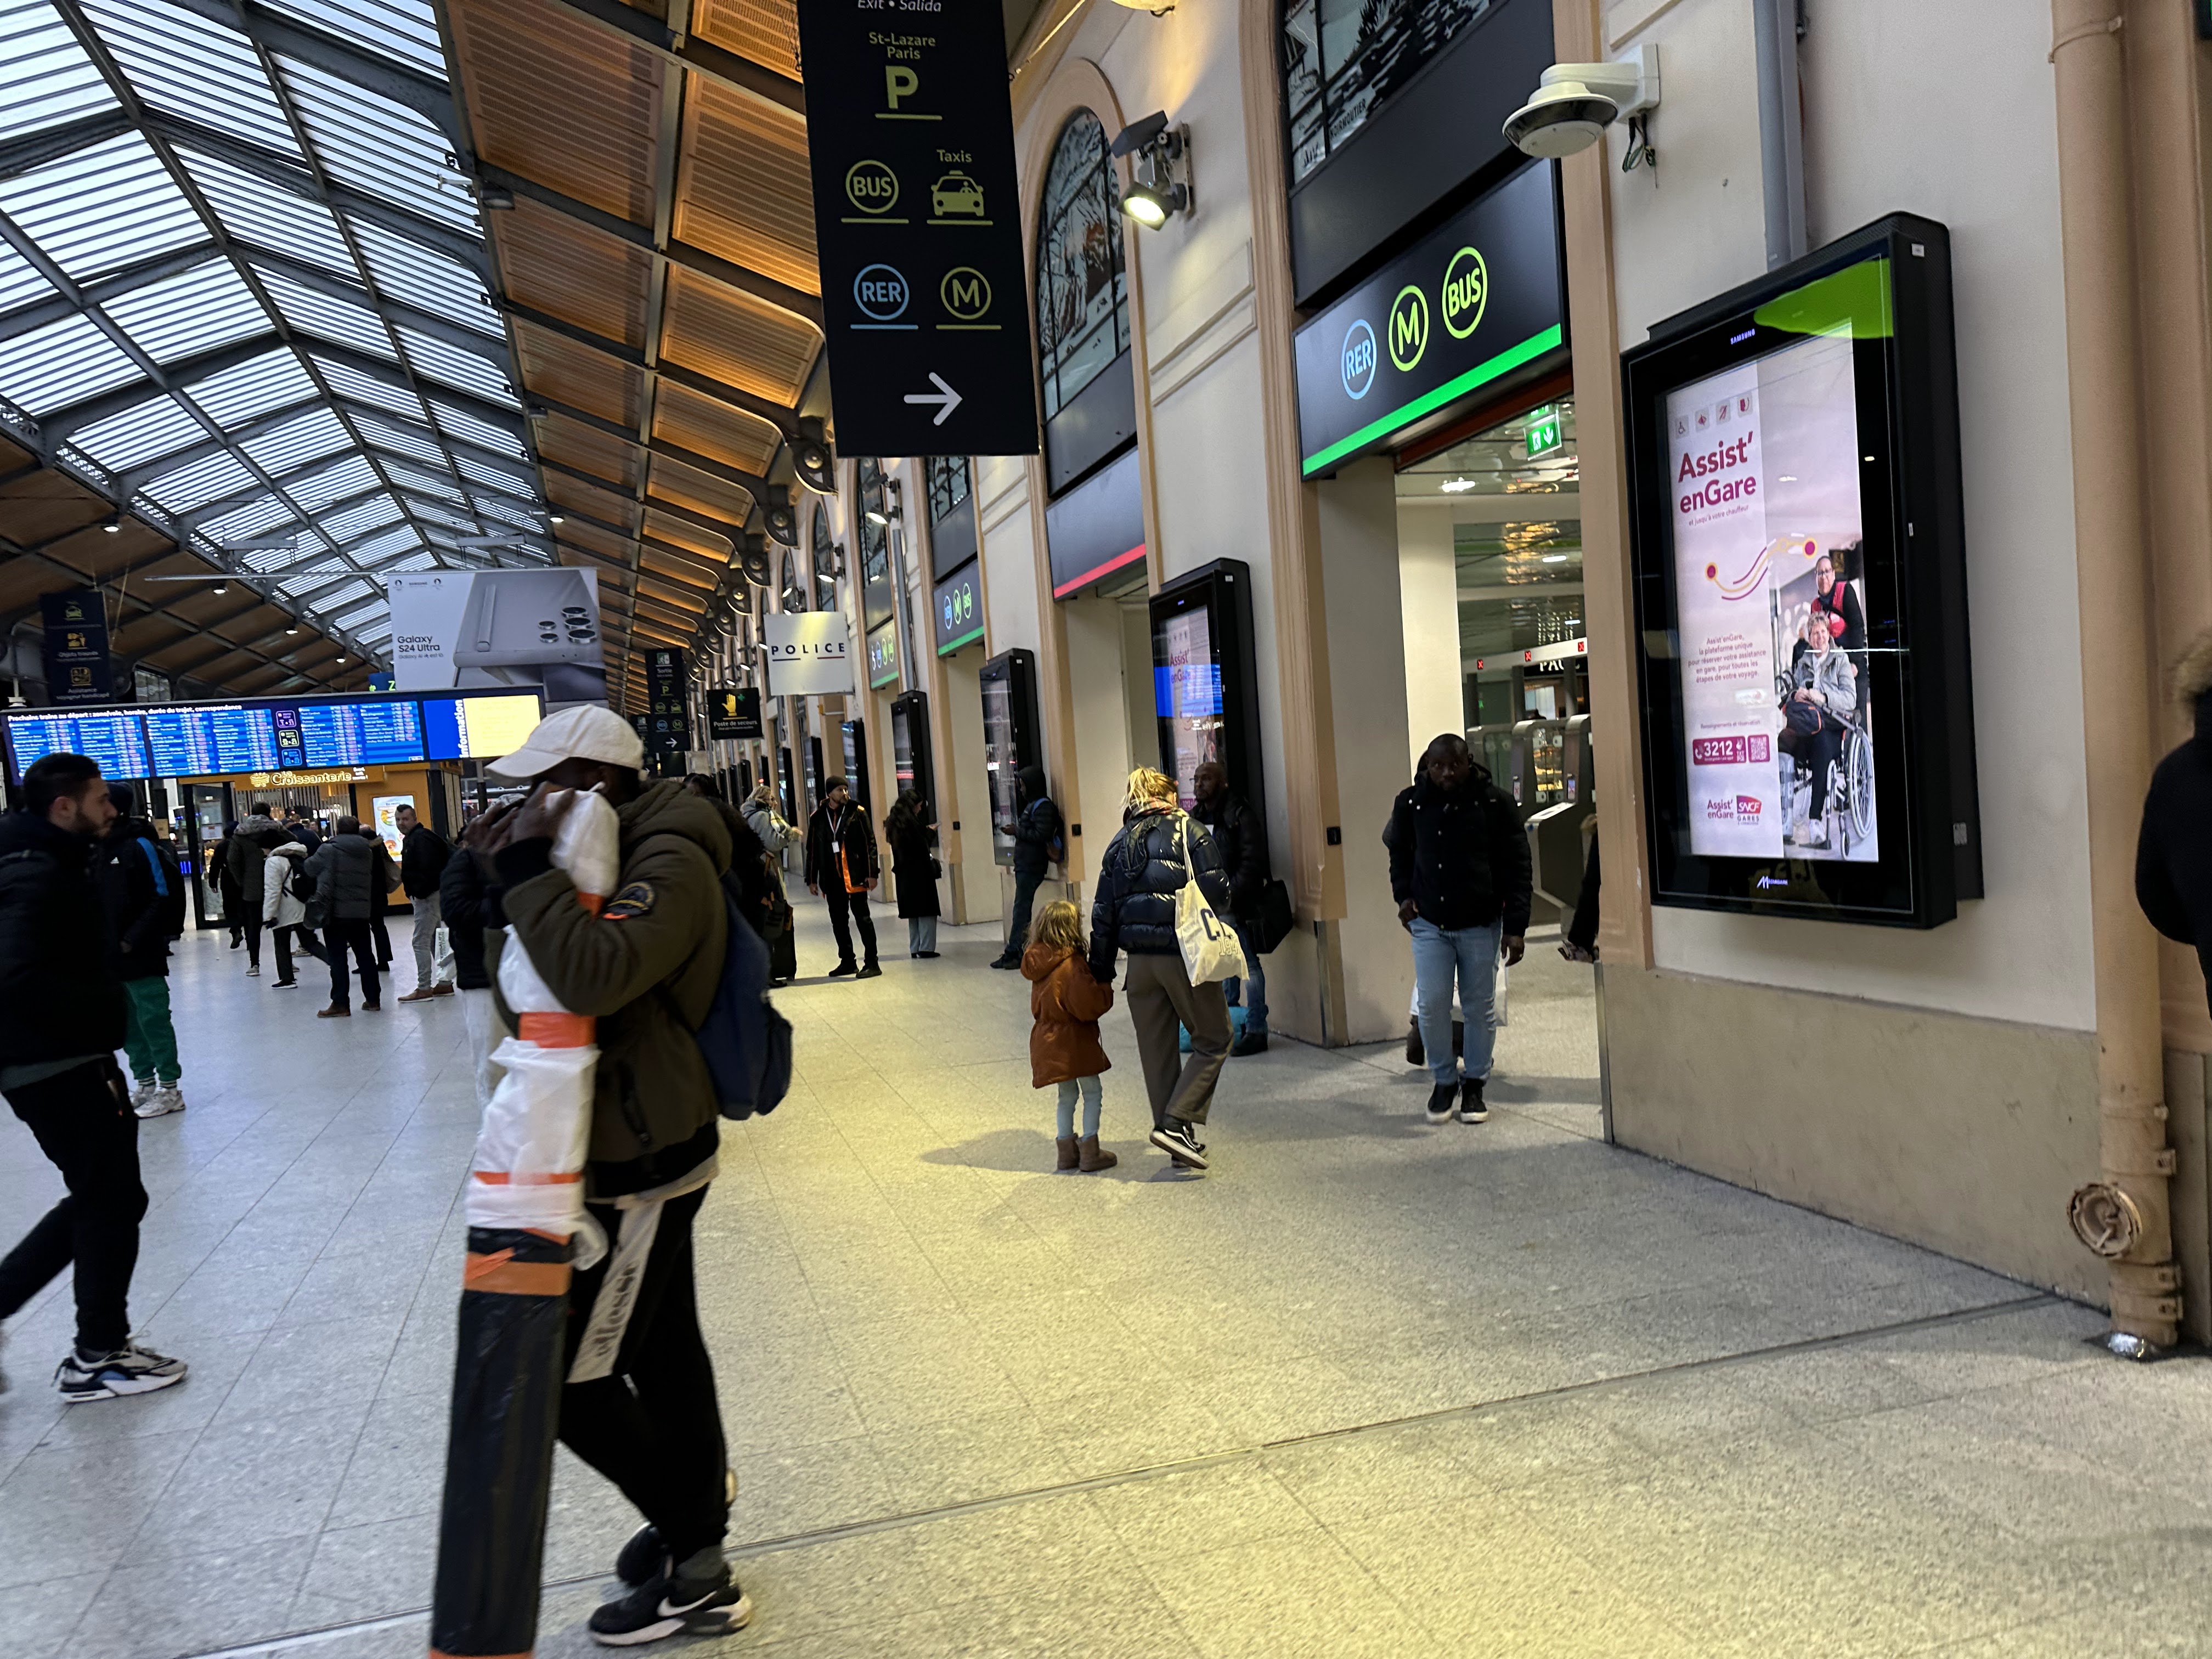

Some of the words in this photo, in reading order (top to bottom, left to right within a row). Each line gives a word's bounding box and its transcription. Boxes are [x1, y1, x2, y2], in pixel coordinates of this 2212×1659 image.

[857, 0, 884, 10] Exit
[899, 0, 942, 13] Salida
[868, 31, 936, 47] St-Lazare
[887, 46, 921, 59] Paris
[885, 66, 918, 109] P
[936, 149, 972, 163] Taxis
[853, 176, 892, 198] BUS
[862, 281, 902, 303] RER
[953, 279, 979, 308] M
[1346, 341, 1372, 380] RER
[1397, 301, 1419, 355] M
[1448, 267, 1481, 318] BUS
[1730, 329, 1756, 345] SAMSUNG
[1678, 431, 1753, 482] Assist'
[1680, 476, 1757, 513] enGare
[397, 635, 433, 644] Galaxy
[771, 642, 845, 656] POLICE
[1705, 645, 1733, 656] plateforme
[1734, 642, 1753, 650] unique
[1739, 650, 1766, 659] assistance
[1696, 675, 1713, 684] étapes
[662, 686, 669, 694] P
[195, 704, 242, 713] correspondance
[1704, 741, 1734, 757] 3212
[272, 771, 352, 786] Croissanterie
[1707, 799, 1733, 810] Assist'
[1738, 802, 1760, 812] SNCF
[1708, 810, 1734, 819] enGare
